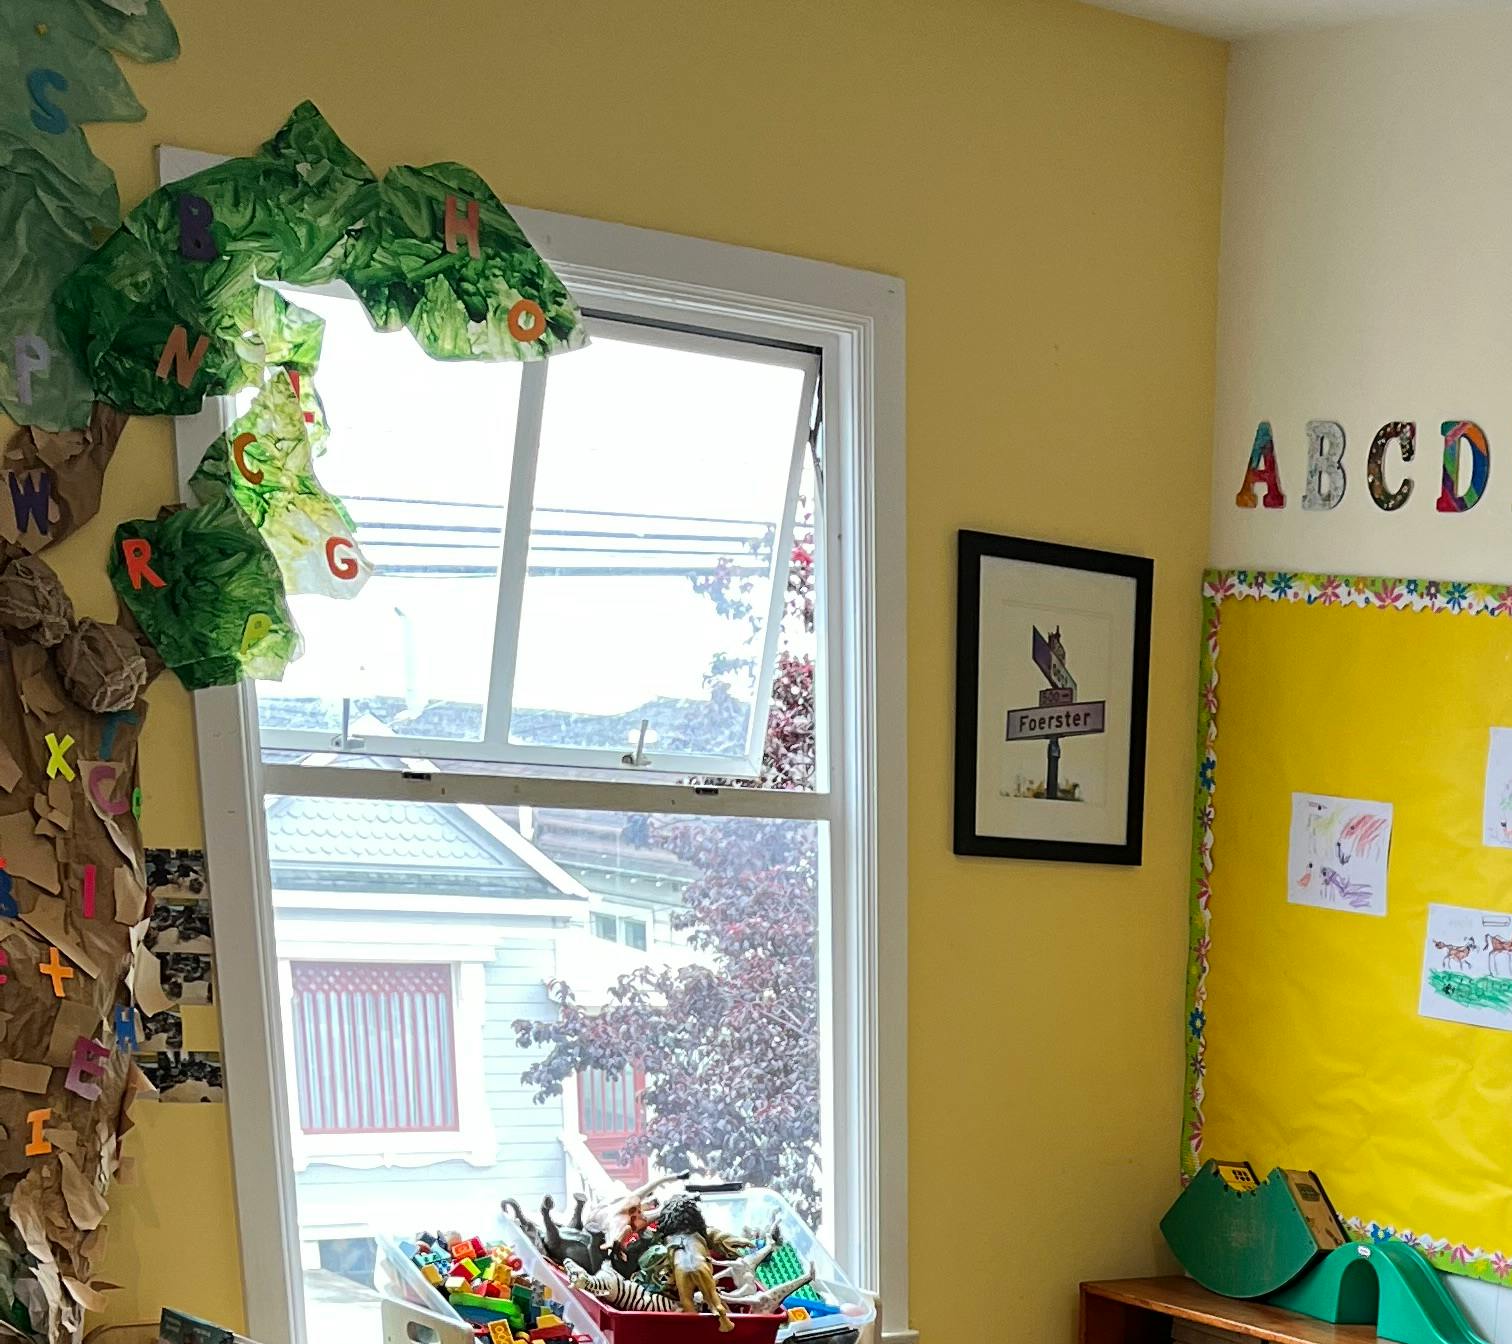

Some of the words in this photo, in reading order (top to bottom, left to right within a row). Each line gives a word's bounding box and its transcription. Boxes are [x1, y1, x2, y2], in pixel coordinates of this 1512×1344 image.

[26, 67, 70, 135] S
[178, 194, 218, 262] B
[444, 195, 480, 260] H
[507, 299, 546, 343] O
[13, 333, 50, 406] P
[155, 324, 210, 389] N
[232, 431, 265, 486] C
[1236, 421, 1286, 511] A
[1302, 420, 1348, 513] B
[1367, 421, 1417, 513] C
[1436, 420, 1490, 514] D
[8, 472, 50, 536] W
[122, 538, 168, 591] R
[325, 535, 359, 581] G
[1019, 711, 1091, 733] Foerster
[44, 732, 77, 783] X
[88, 764, 131, 816] C
[64, 1035, 111, 1101] E
[25, 1107, 52, 1157] I
